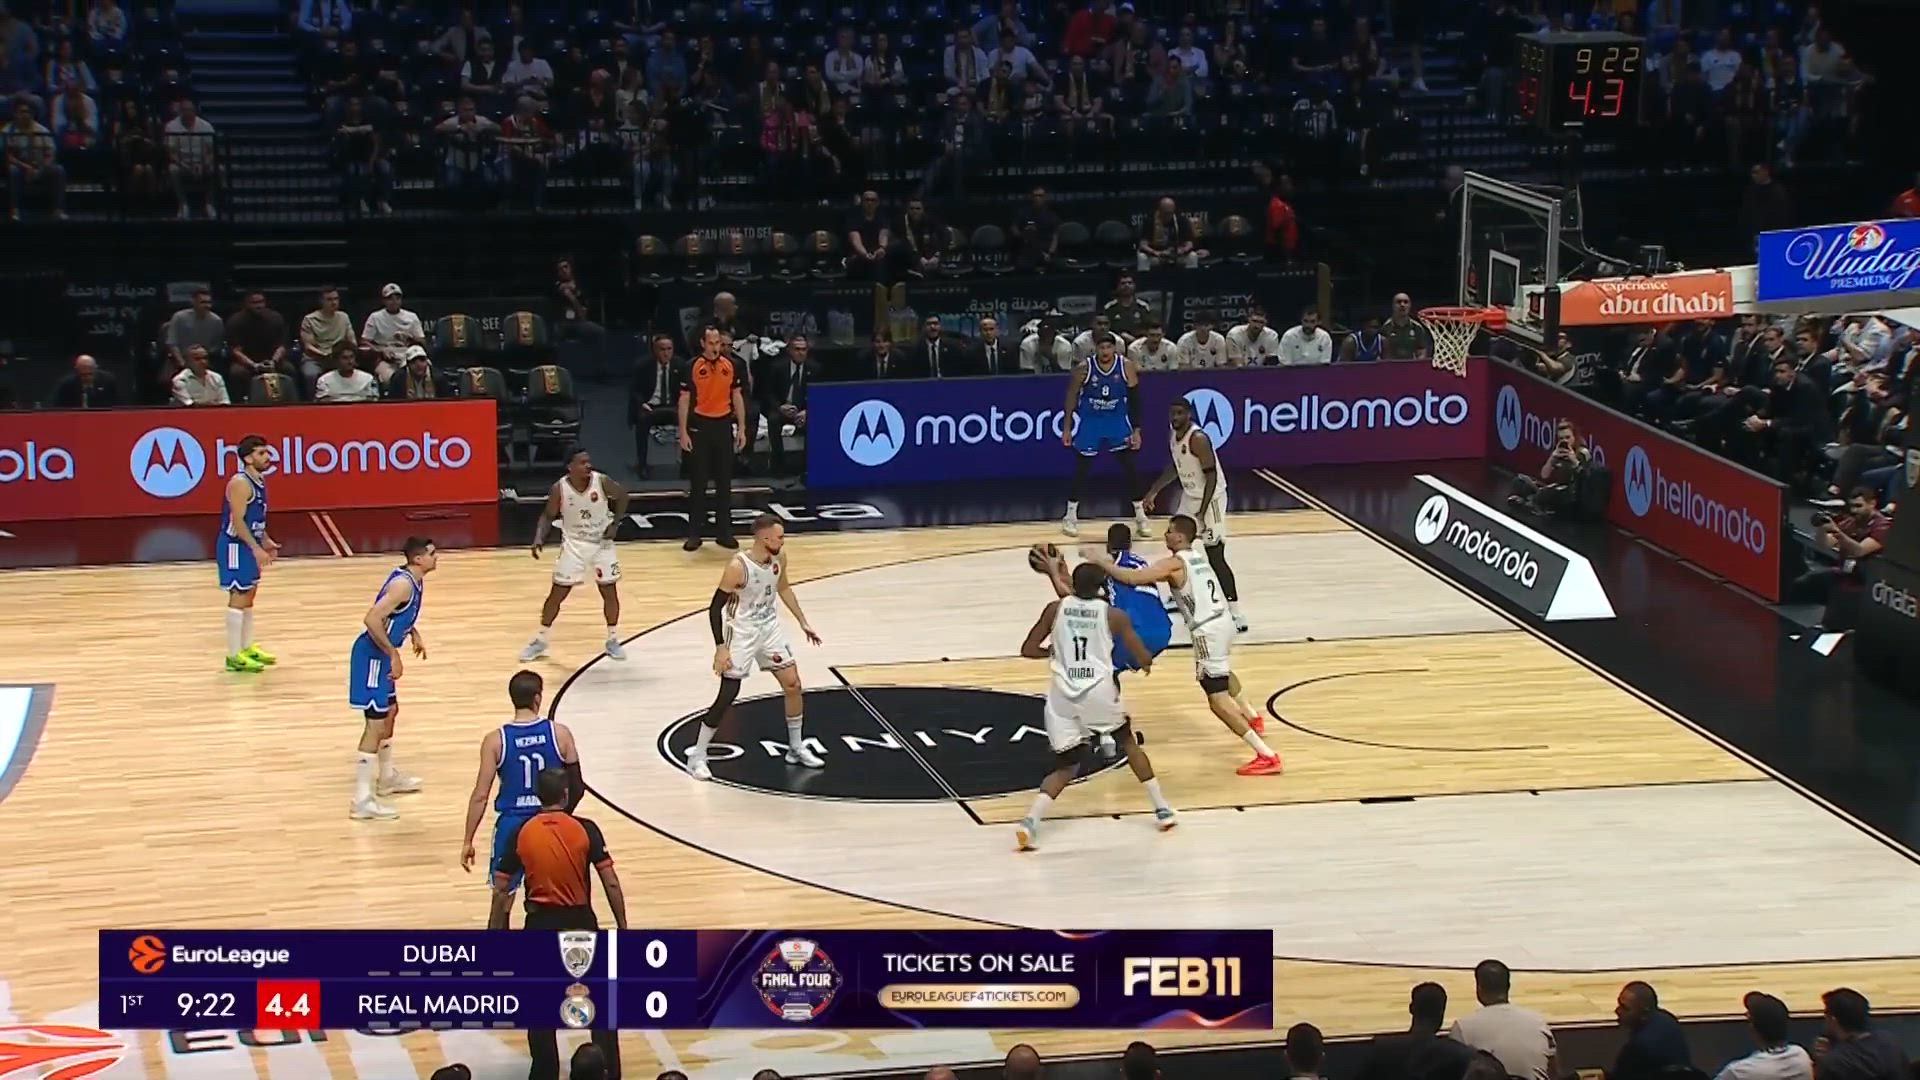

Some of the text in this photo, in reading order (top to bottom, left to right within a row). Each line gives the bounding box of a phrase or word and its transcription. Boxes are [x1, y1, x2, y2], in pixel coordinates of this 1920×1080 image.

[1576, 47, 1640, 74] 9 22
[1568, 79, 1625, 116] 4.3
[1602, 280, 1669, 294] experience
[1599, 293, 1648, 315] abu
[1101, 384, 1110, 396] 8
[915, 405, 1080, 446] motoro
[1243, 389, 1469, 434] hellomoto
[1655, 468, 1766, 555] hellomoto
[1445, 520, 1540, 589] motorola
[1207, 579, 1219, 603] 2
[1871, 579, 1918, 619] dnata
[1072, 636, 1088, 662] 17
